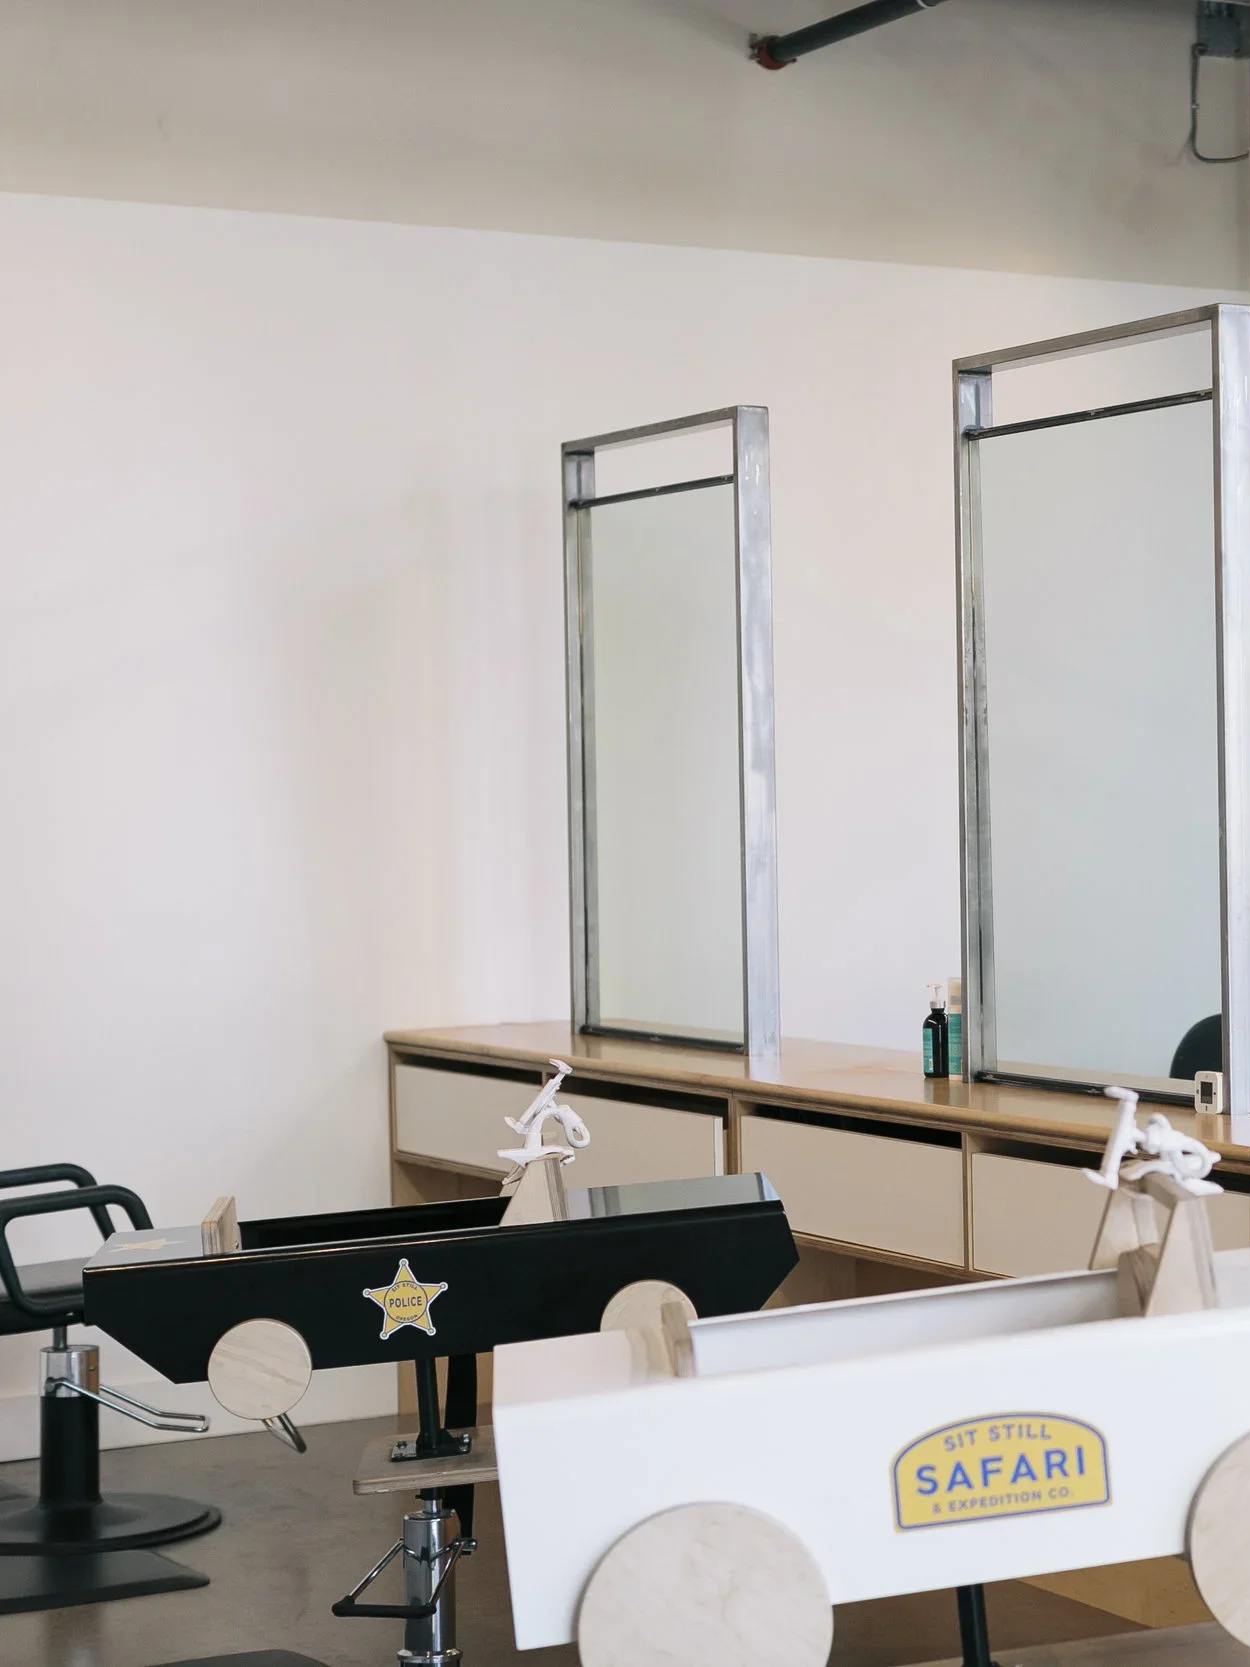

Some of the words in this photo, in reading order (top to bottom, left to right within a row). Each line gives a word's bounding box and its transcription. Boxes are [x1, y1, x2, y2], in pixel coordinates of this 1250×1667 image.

[389, 1296, 422, 1308] POLICE
[943, 1429, 978, 1452] SIT
[988, 1423, 1052, 1442] STILL
[915, 1445, 1086, 1496] SAFARI
[932, 1503, 942, 1515] &
[948, 1491, 1042, 1513] EXPEDITION
